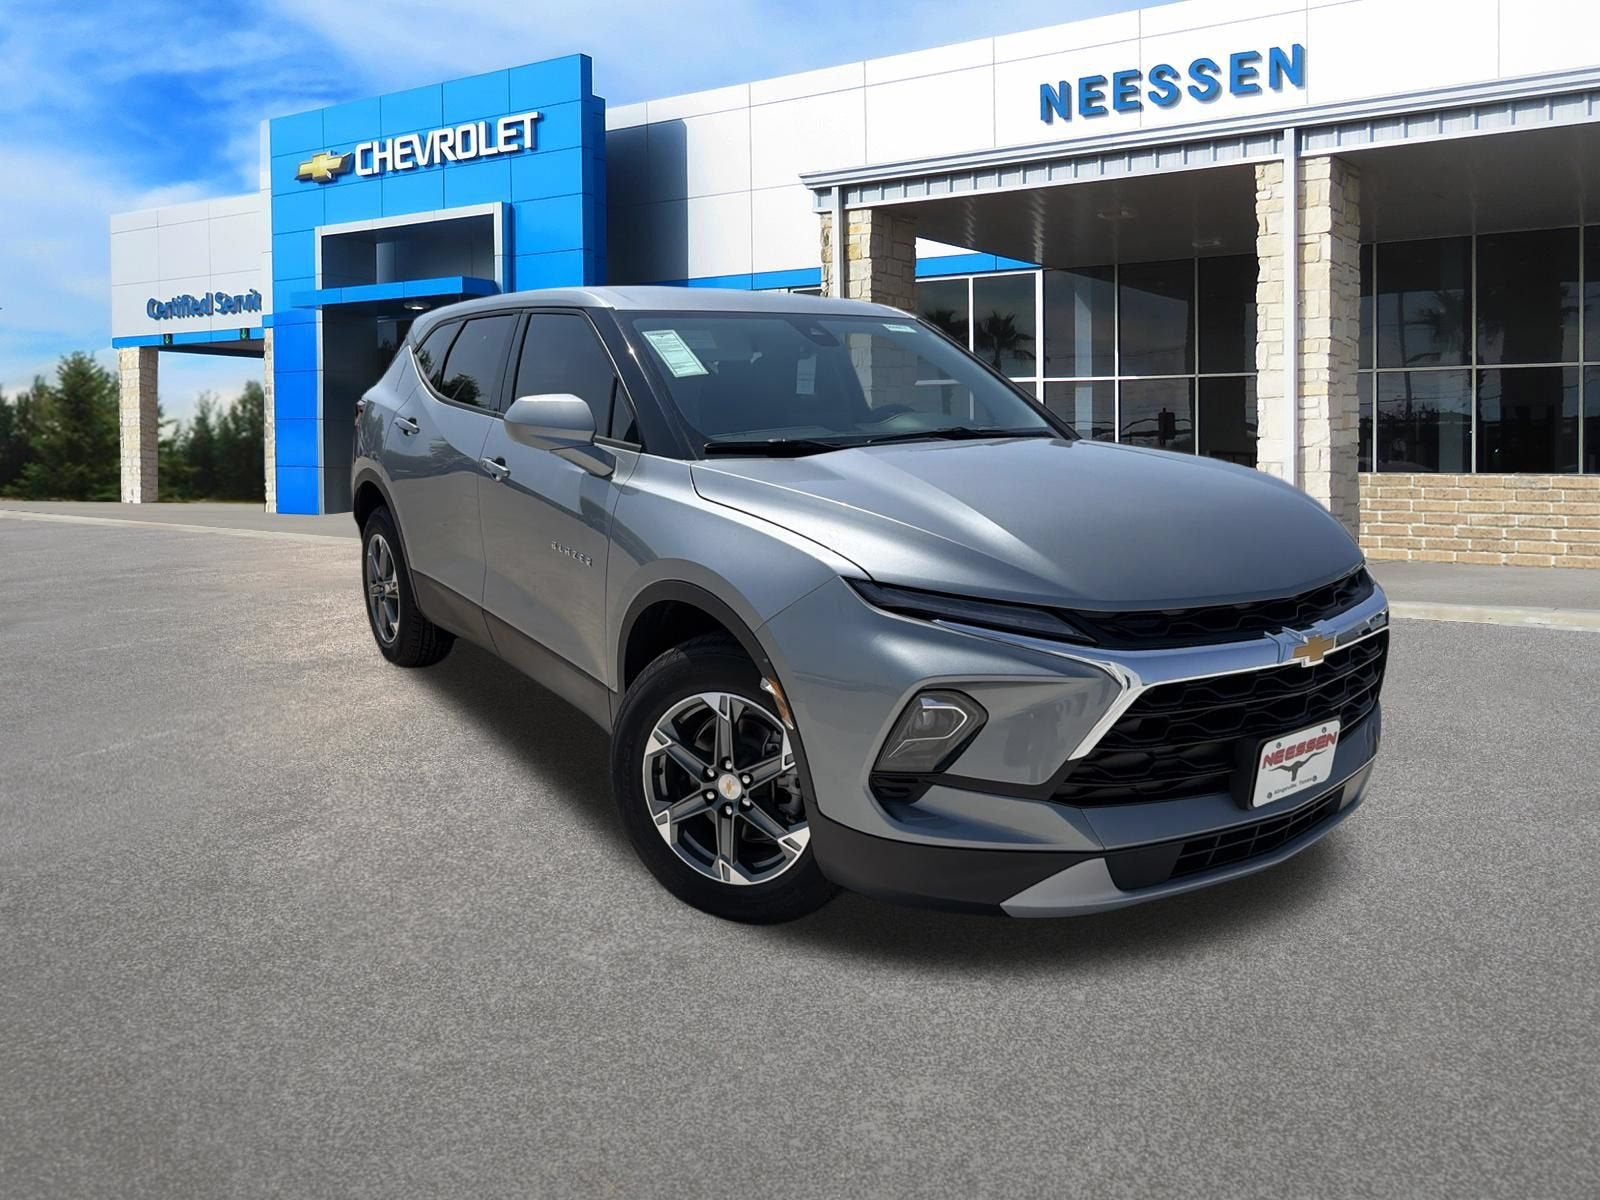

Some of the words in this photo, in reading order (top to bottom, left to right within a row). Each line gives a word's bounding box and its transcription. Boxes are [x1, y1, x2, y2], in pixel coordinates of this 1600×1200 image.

[1039, 43, 1306, 124] NEESSEN
[354, 111, 542, 177] CHEVROLET
[146, 292, 213, 320] Certified
[1261, 731, 1338, 770] NEESSEN
